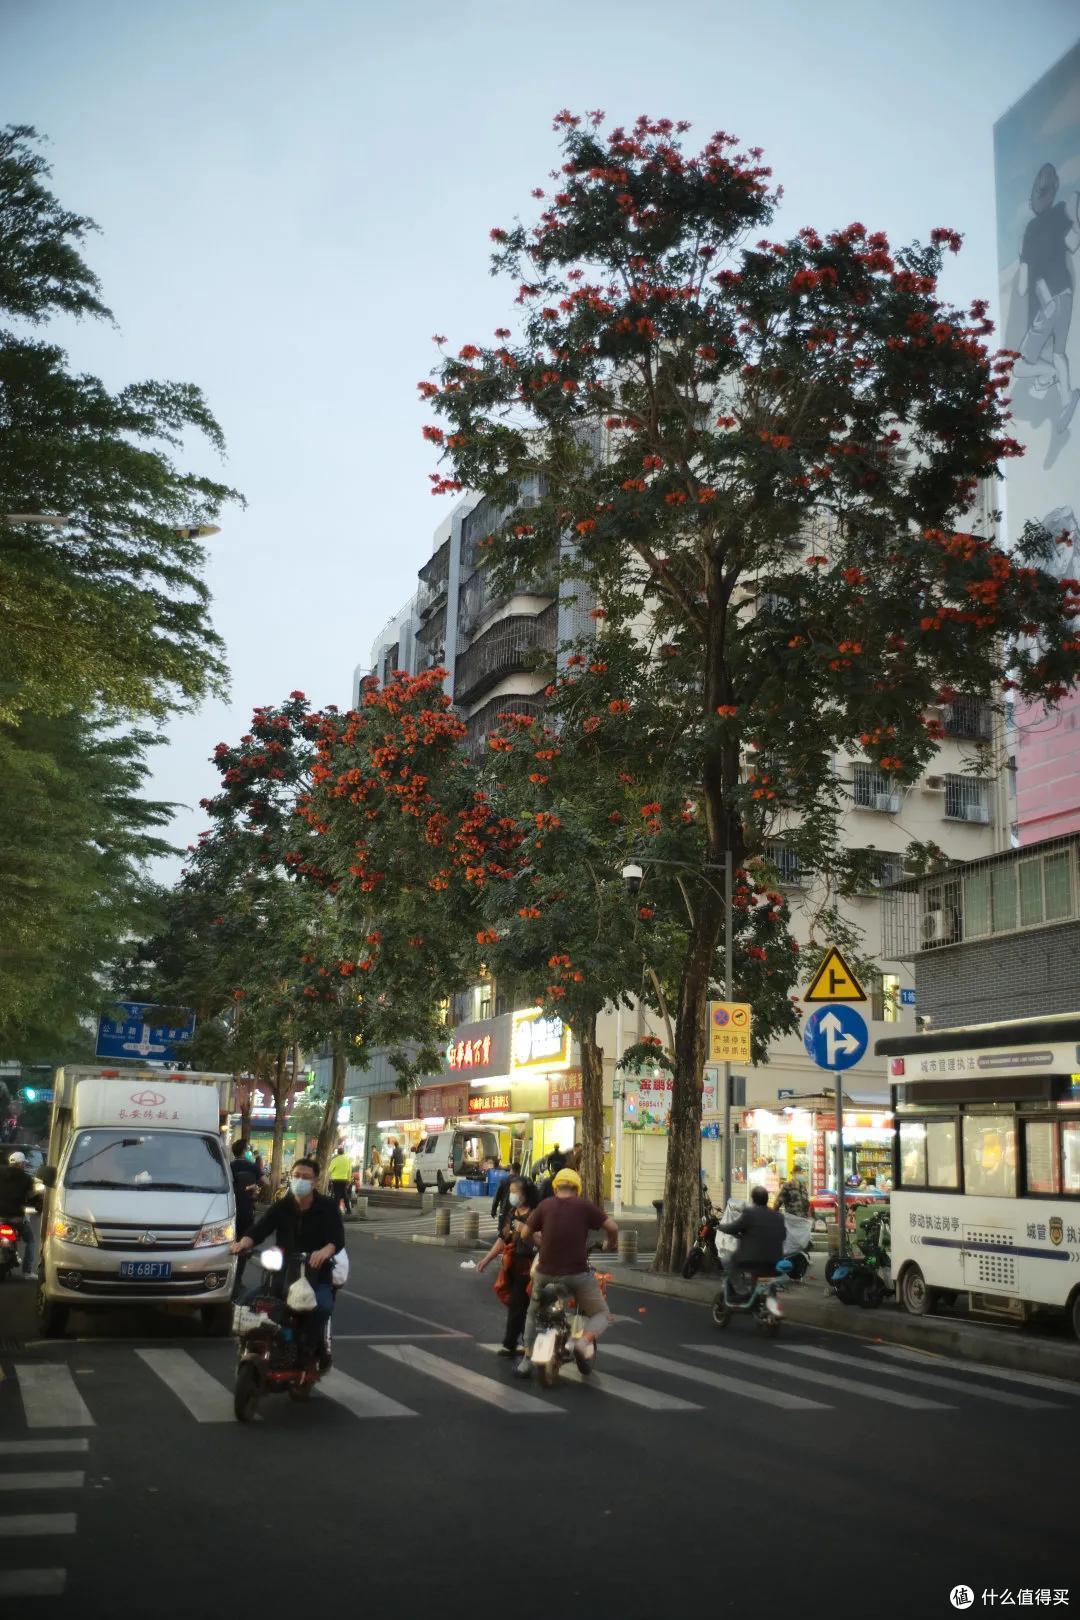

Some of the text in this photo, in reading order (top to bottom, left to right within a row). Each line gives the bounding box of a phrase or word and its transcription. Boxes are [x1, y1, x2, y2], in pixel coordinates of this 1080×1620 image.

[713, 1035, 747, 1044] 严禁停车
[713, 1046, 747, 1056] 违停抓拍
[921, 1056, 975, 1072] 城市管理执法
[909, 1213, 960, 1232] 移动执法岗亭
[1026, 1222, 1046, 1241] 城管
